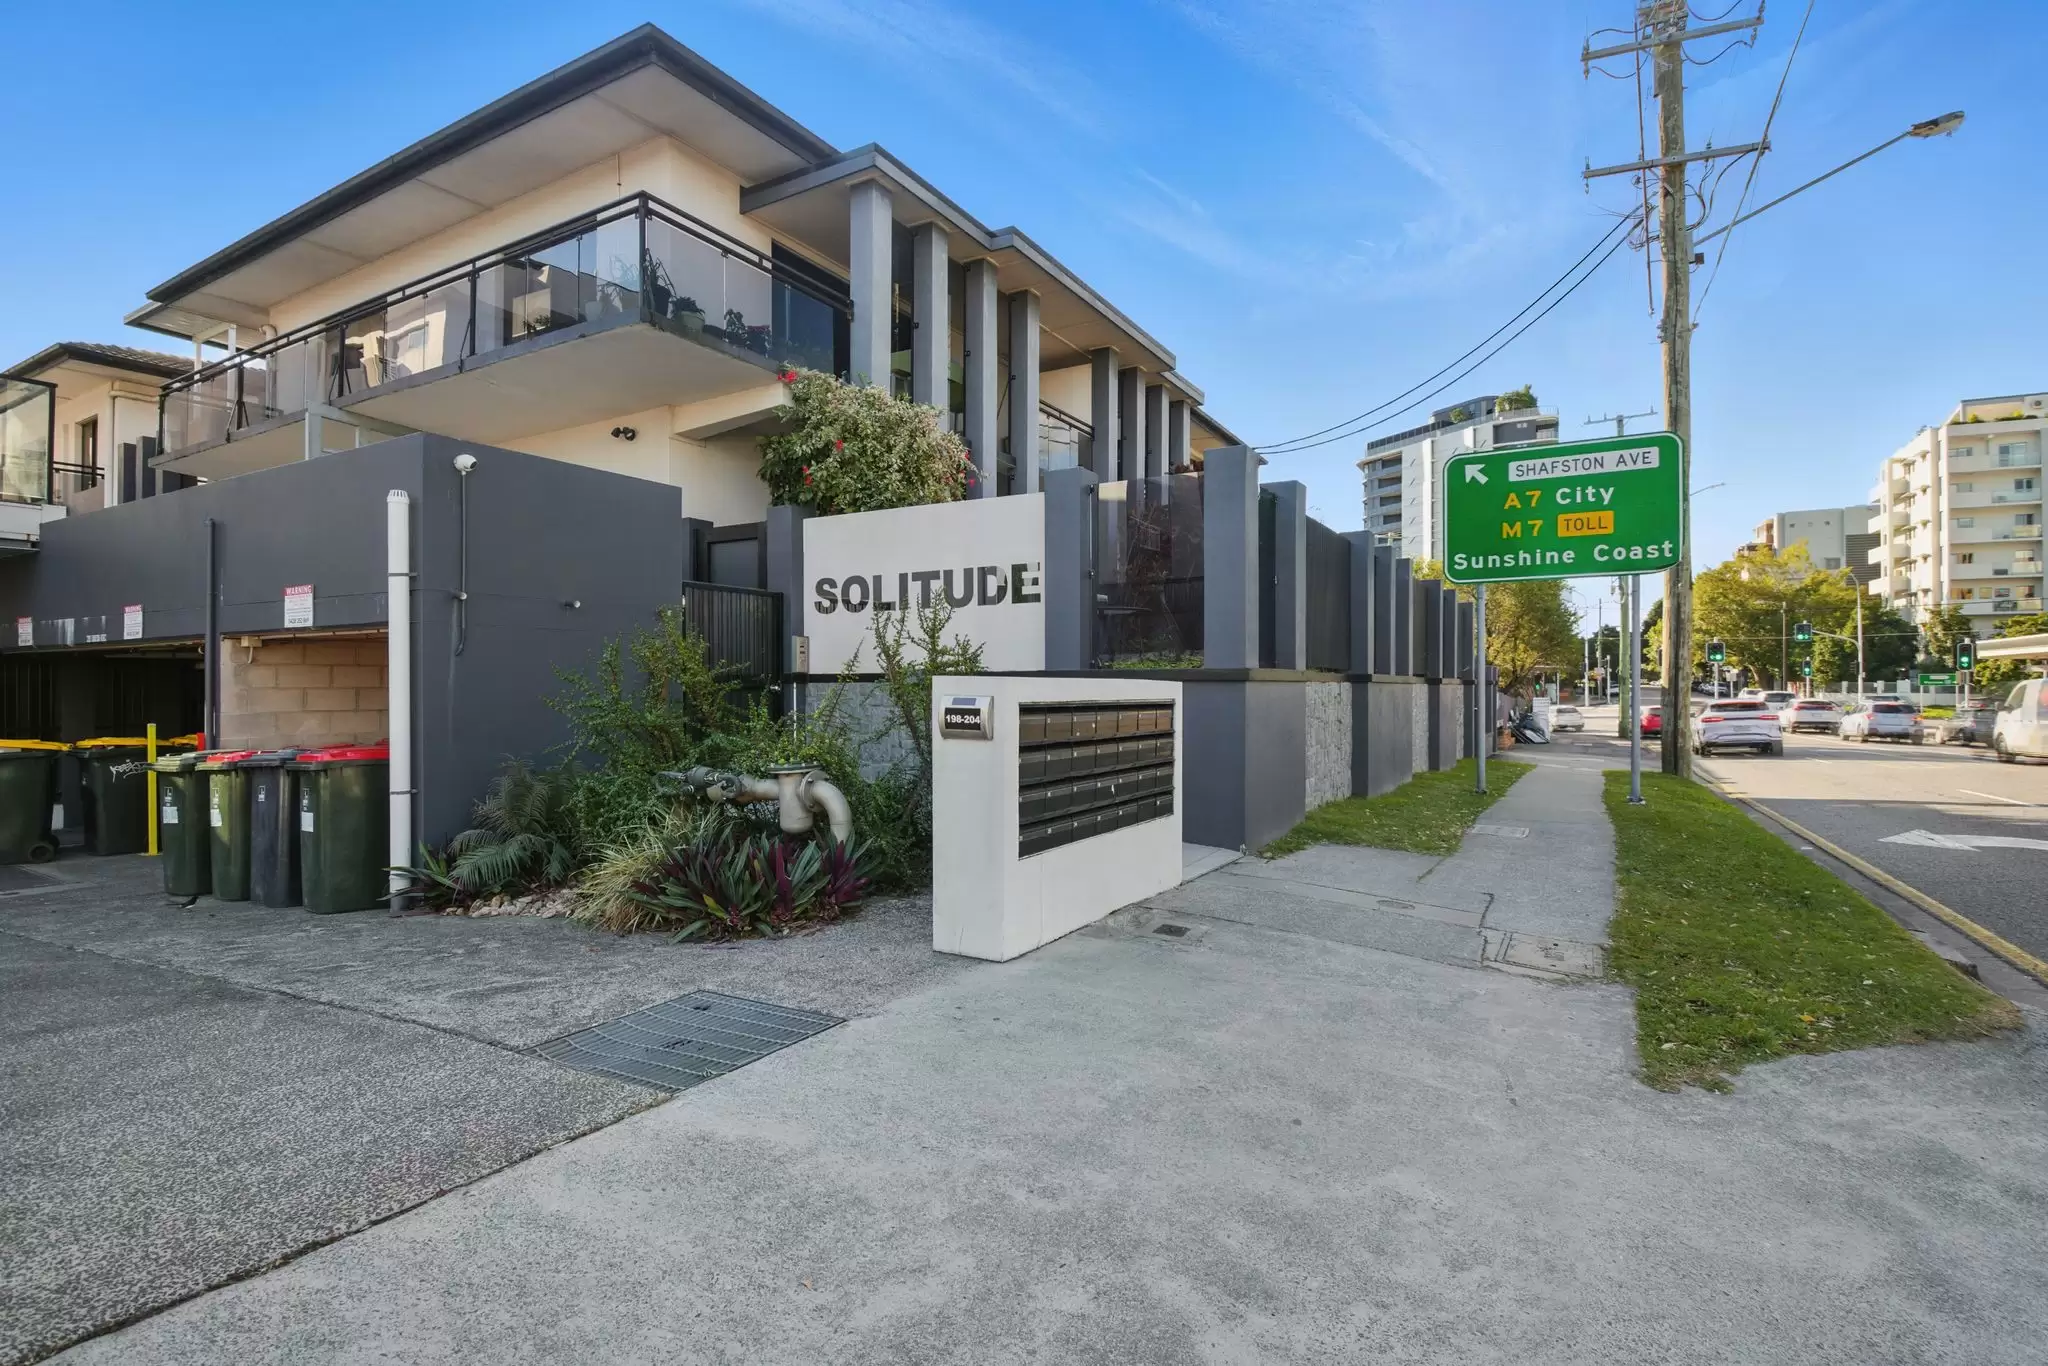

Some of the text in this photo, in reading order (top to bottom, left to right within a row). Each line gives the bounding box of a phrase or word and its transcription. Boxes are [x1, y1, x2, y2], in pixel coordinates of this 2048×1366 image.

[1515, 450, 1653, 478] SHAFSTON AVE
[1555, 486, 1615, 505] City
[1564, 517, 1608, 532] TOLL
[1453, 540, 1674, 570] Sunshine Coast
[814, 562, 1041, 615] SOLITUDE
[945, 714, 981, 725] 198-204
